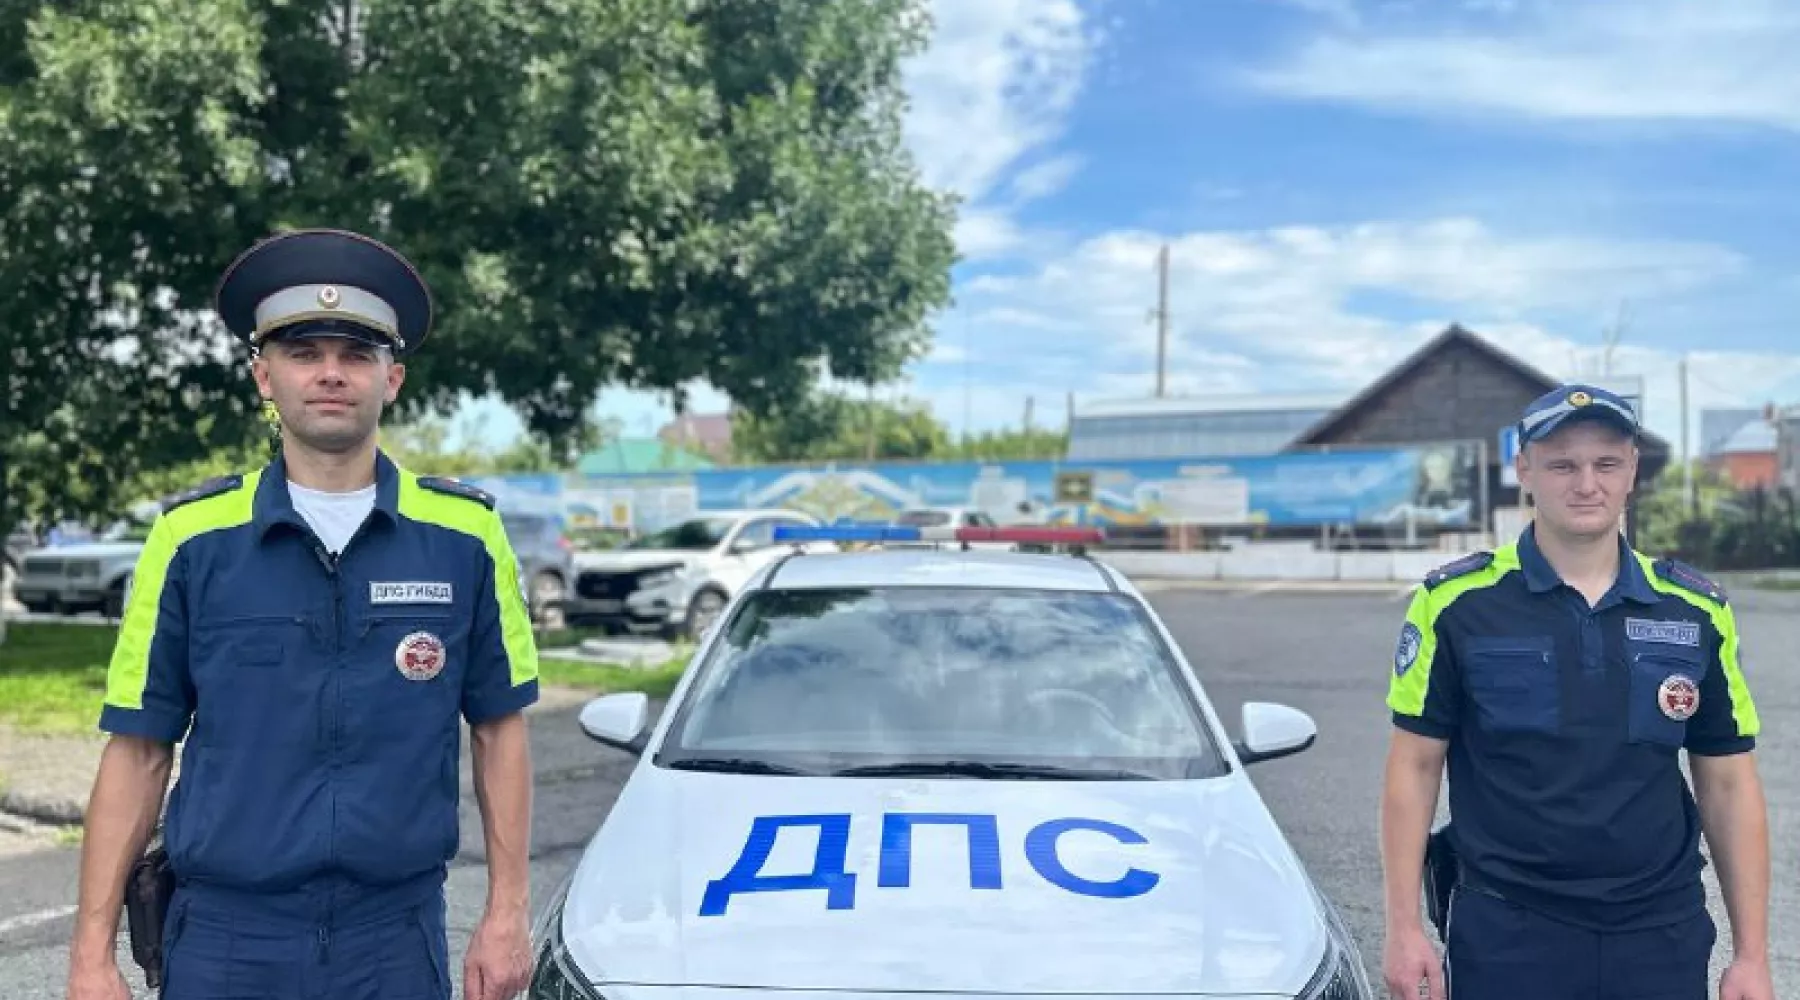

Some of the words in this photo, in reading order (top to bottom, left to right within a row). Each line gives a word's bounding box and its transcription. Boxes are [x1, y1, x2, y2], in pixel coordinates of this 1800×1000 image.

[375, 584, 404, 599] ДПС
[406, 584, 449, 599] ГИБДД
[698, 812, 1160, 916] ДПС
